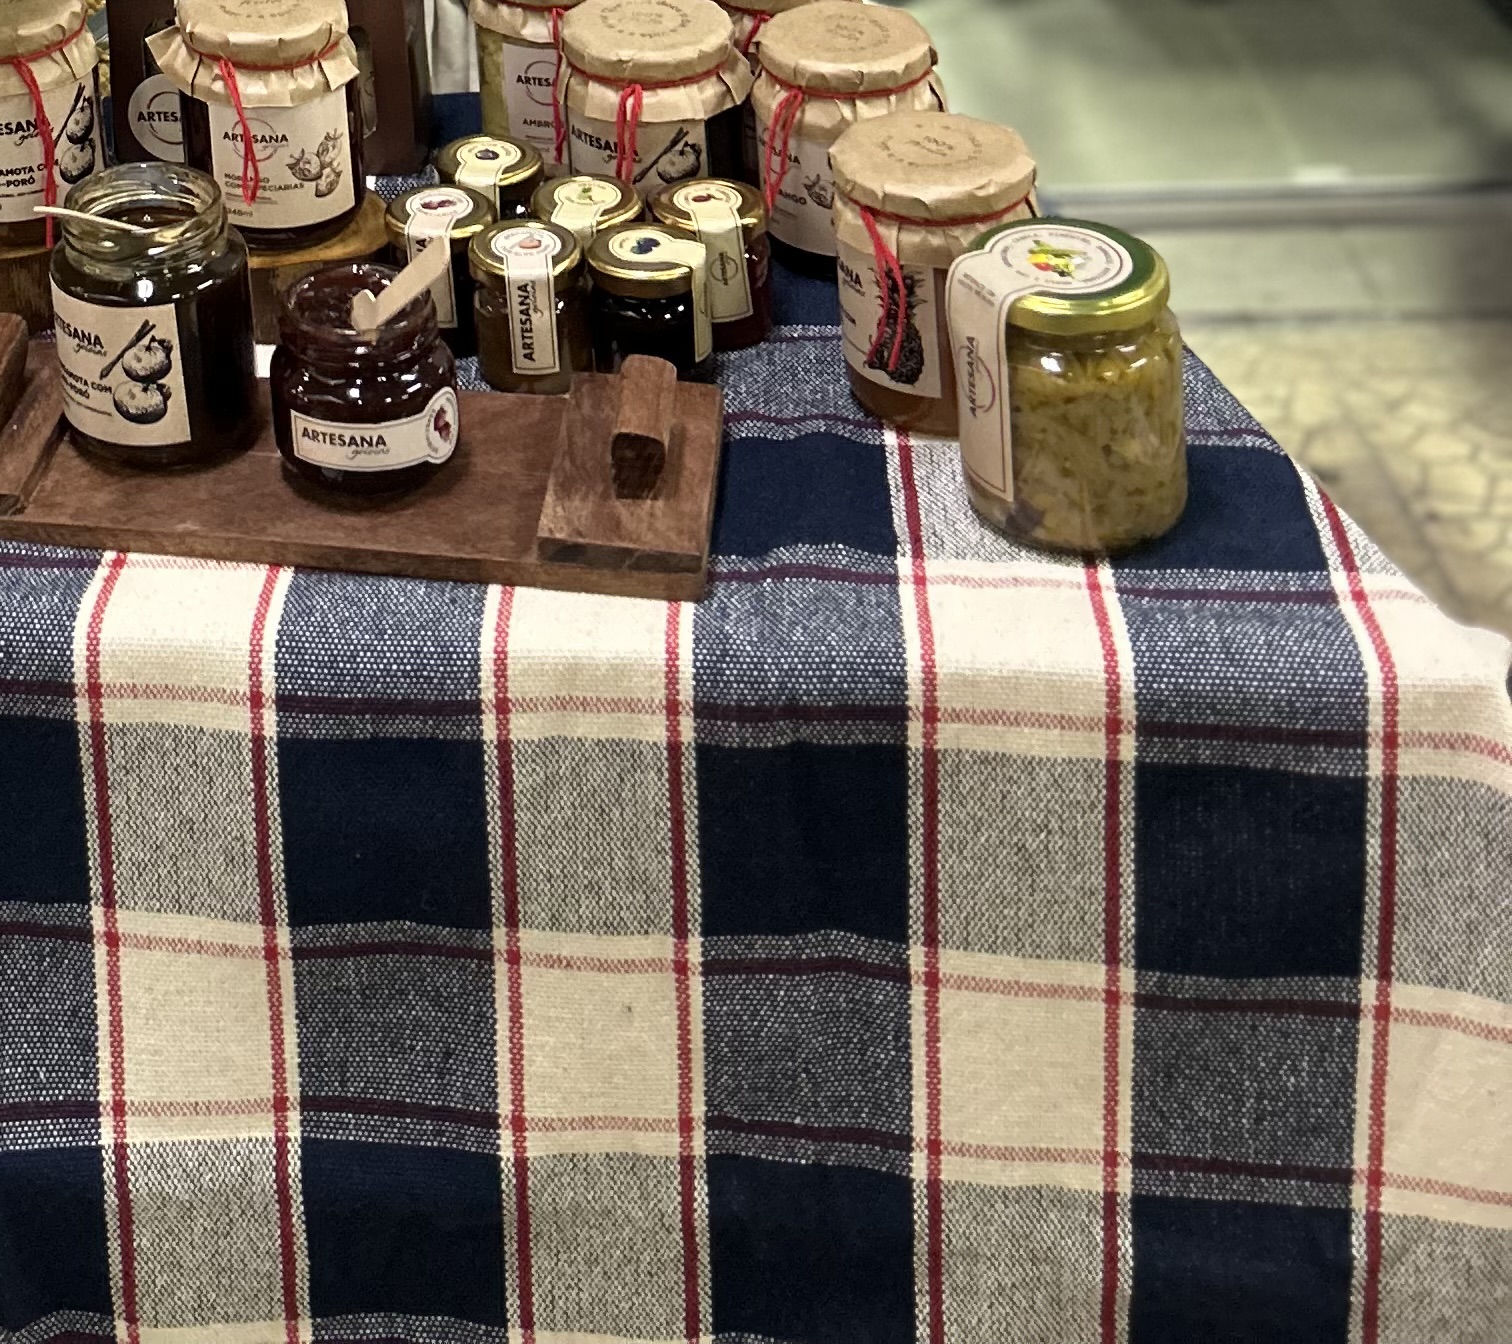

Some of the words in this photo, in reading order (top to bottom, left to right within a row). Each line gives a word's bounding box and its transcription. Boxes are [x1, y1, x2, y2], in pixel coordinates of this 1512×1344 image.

[516, 74, 556, 88] ARTES
[137, 110, 180, 123] ARTES
[223, 131, 289, 144] ARTSANA
[517, 282, 536, 363] ARTESANA
[302, 426, 387, 448] ARTESANA
